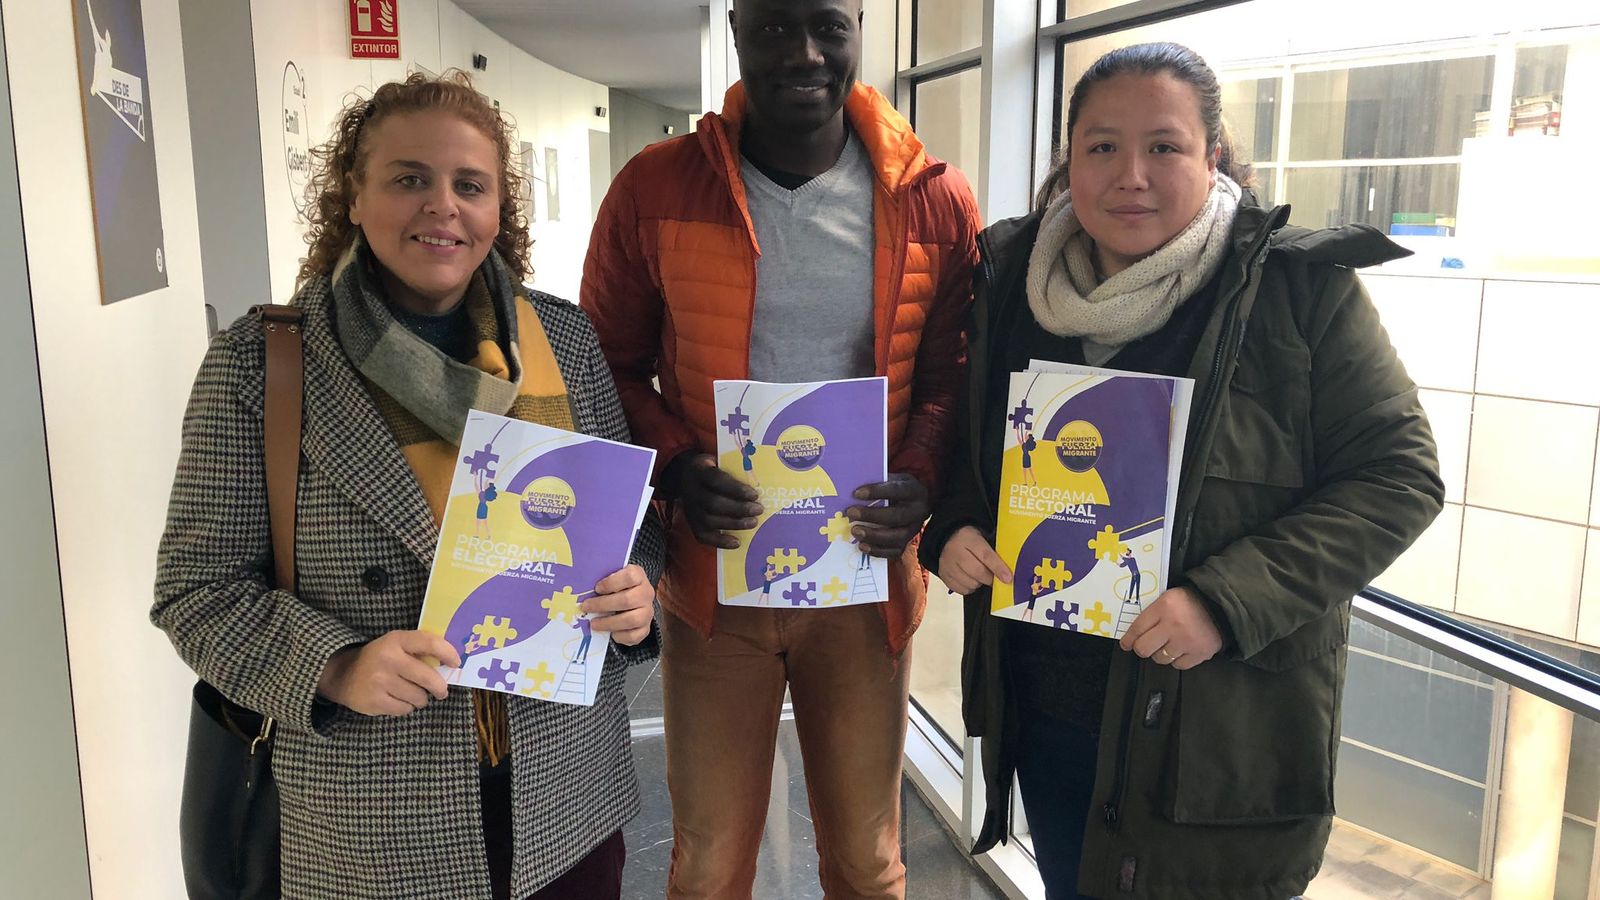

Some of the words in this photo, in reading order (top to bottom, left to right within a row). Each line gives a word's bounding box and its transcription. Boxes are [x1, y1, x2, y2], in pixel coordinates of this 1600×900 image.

[353, 43, 398, 54] EXTINTOR
[781, 438, 819, 446] MOVIMENTO
[783, 443, 819, 452] FUERZA
[1062, 442, 1096, 450] FUERZA
[784, 449, 820, 458] MIGRANTE
[528, 491, 570, 501] MOVIMENTO
[754, 485, 825, 498] OGRAMA
[1010, 484, 1097, 505] PROGRAMA
[528, 497, 568, 509] FUERZA
[761, 497, 825, 510] CTORAL
[1009, 495, 1097, 518] ELECTORAL
[528, 505, 568, 516] MIGRANTE
[1066, 516, 1097, 525] MIGRANTE
[456, 533, 558, 563] PROGRAMA
[453, 547, 556, 577] ELECTORAL
[520, 573, 555, 585] MIGRANTE
